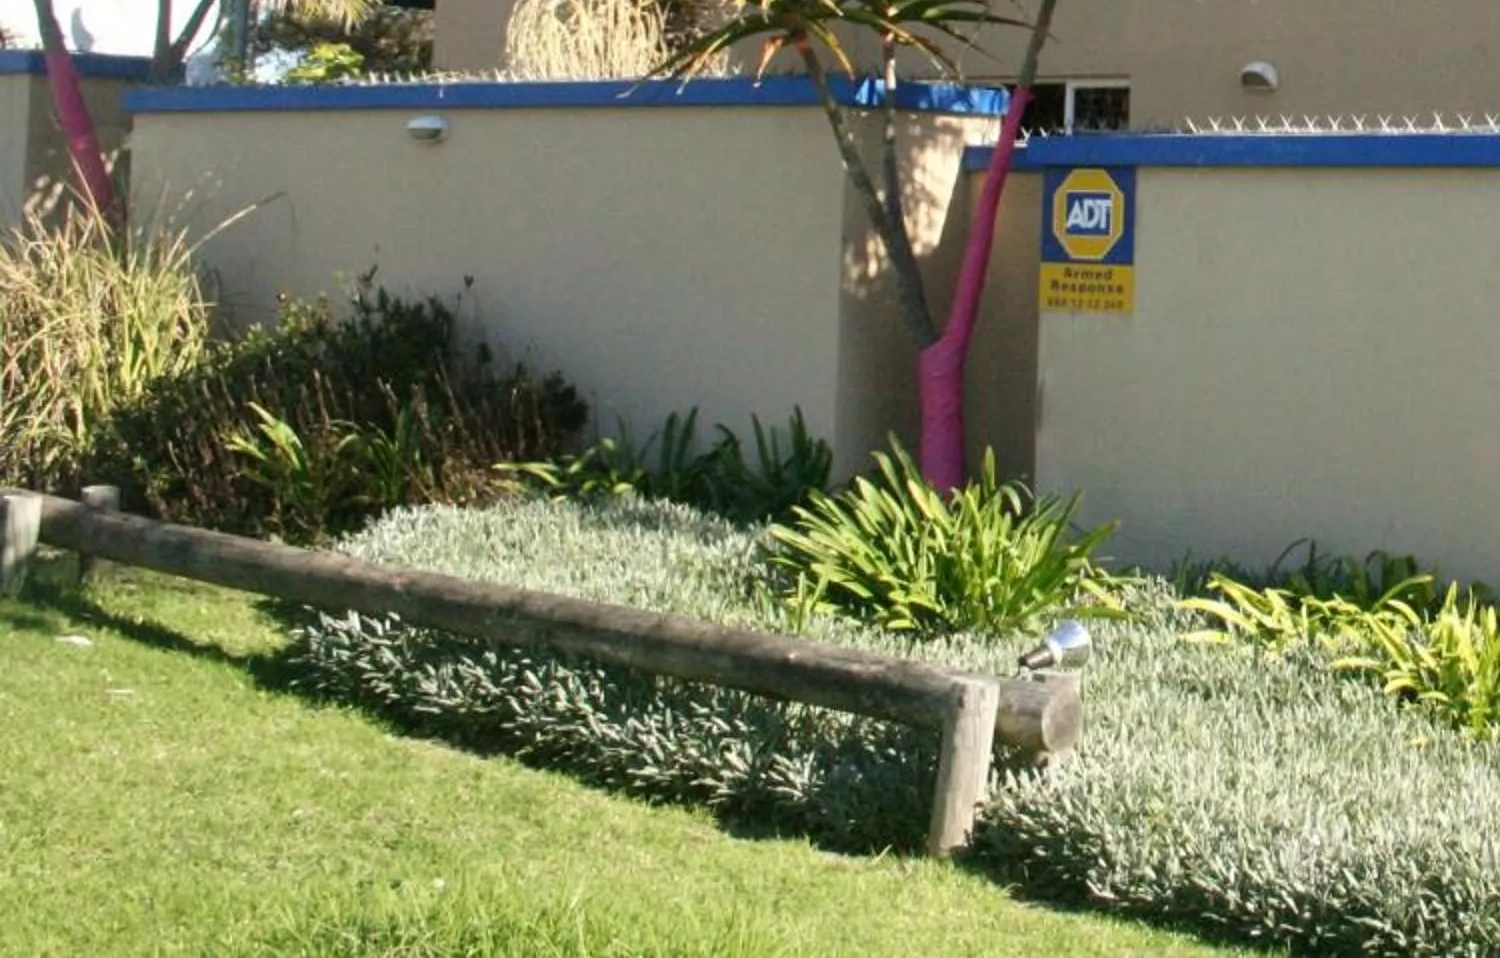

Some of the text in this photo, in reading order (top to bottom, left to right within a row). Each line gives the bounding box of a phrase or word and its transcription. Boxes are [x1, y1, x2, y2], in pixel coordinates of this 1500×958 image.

[1067, 199, 1112, 229] ADT
[1063, 267, 1113, 279] Armed
[1051, 280, 1123, 294] Response
